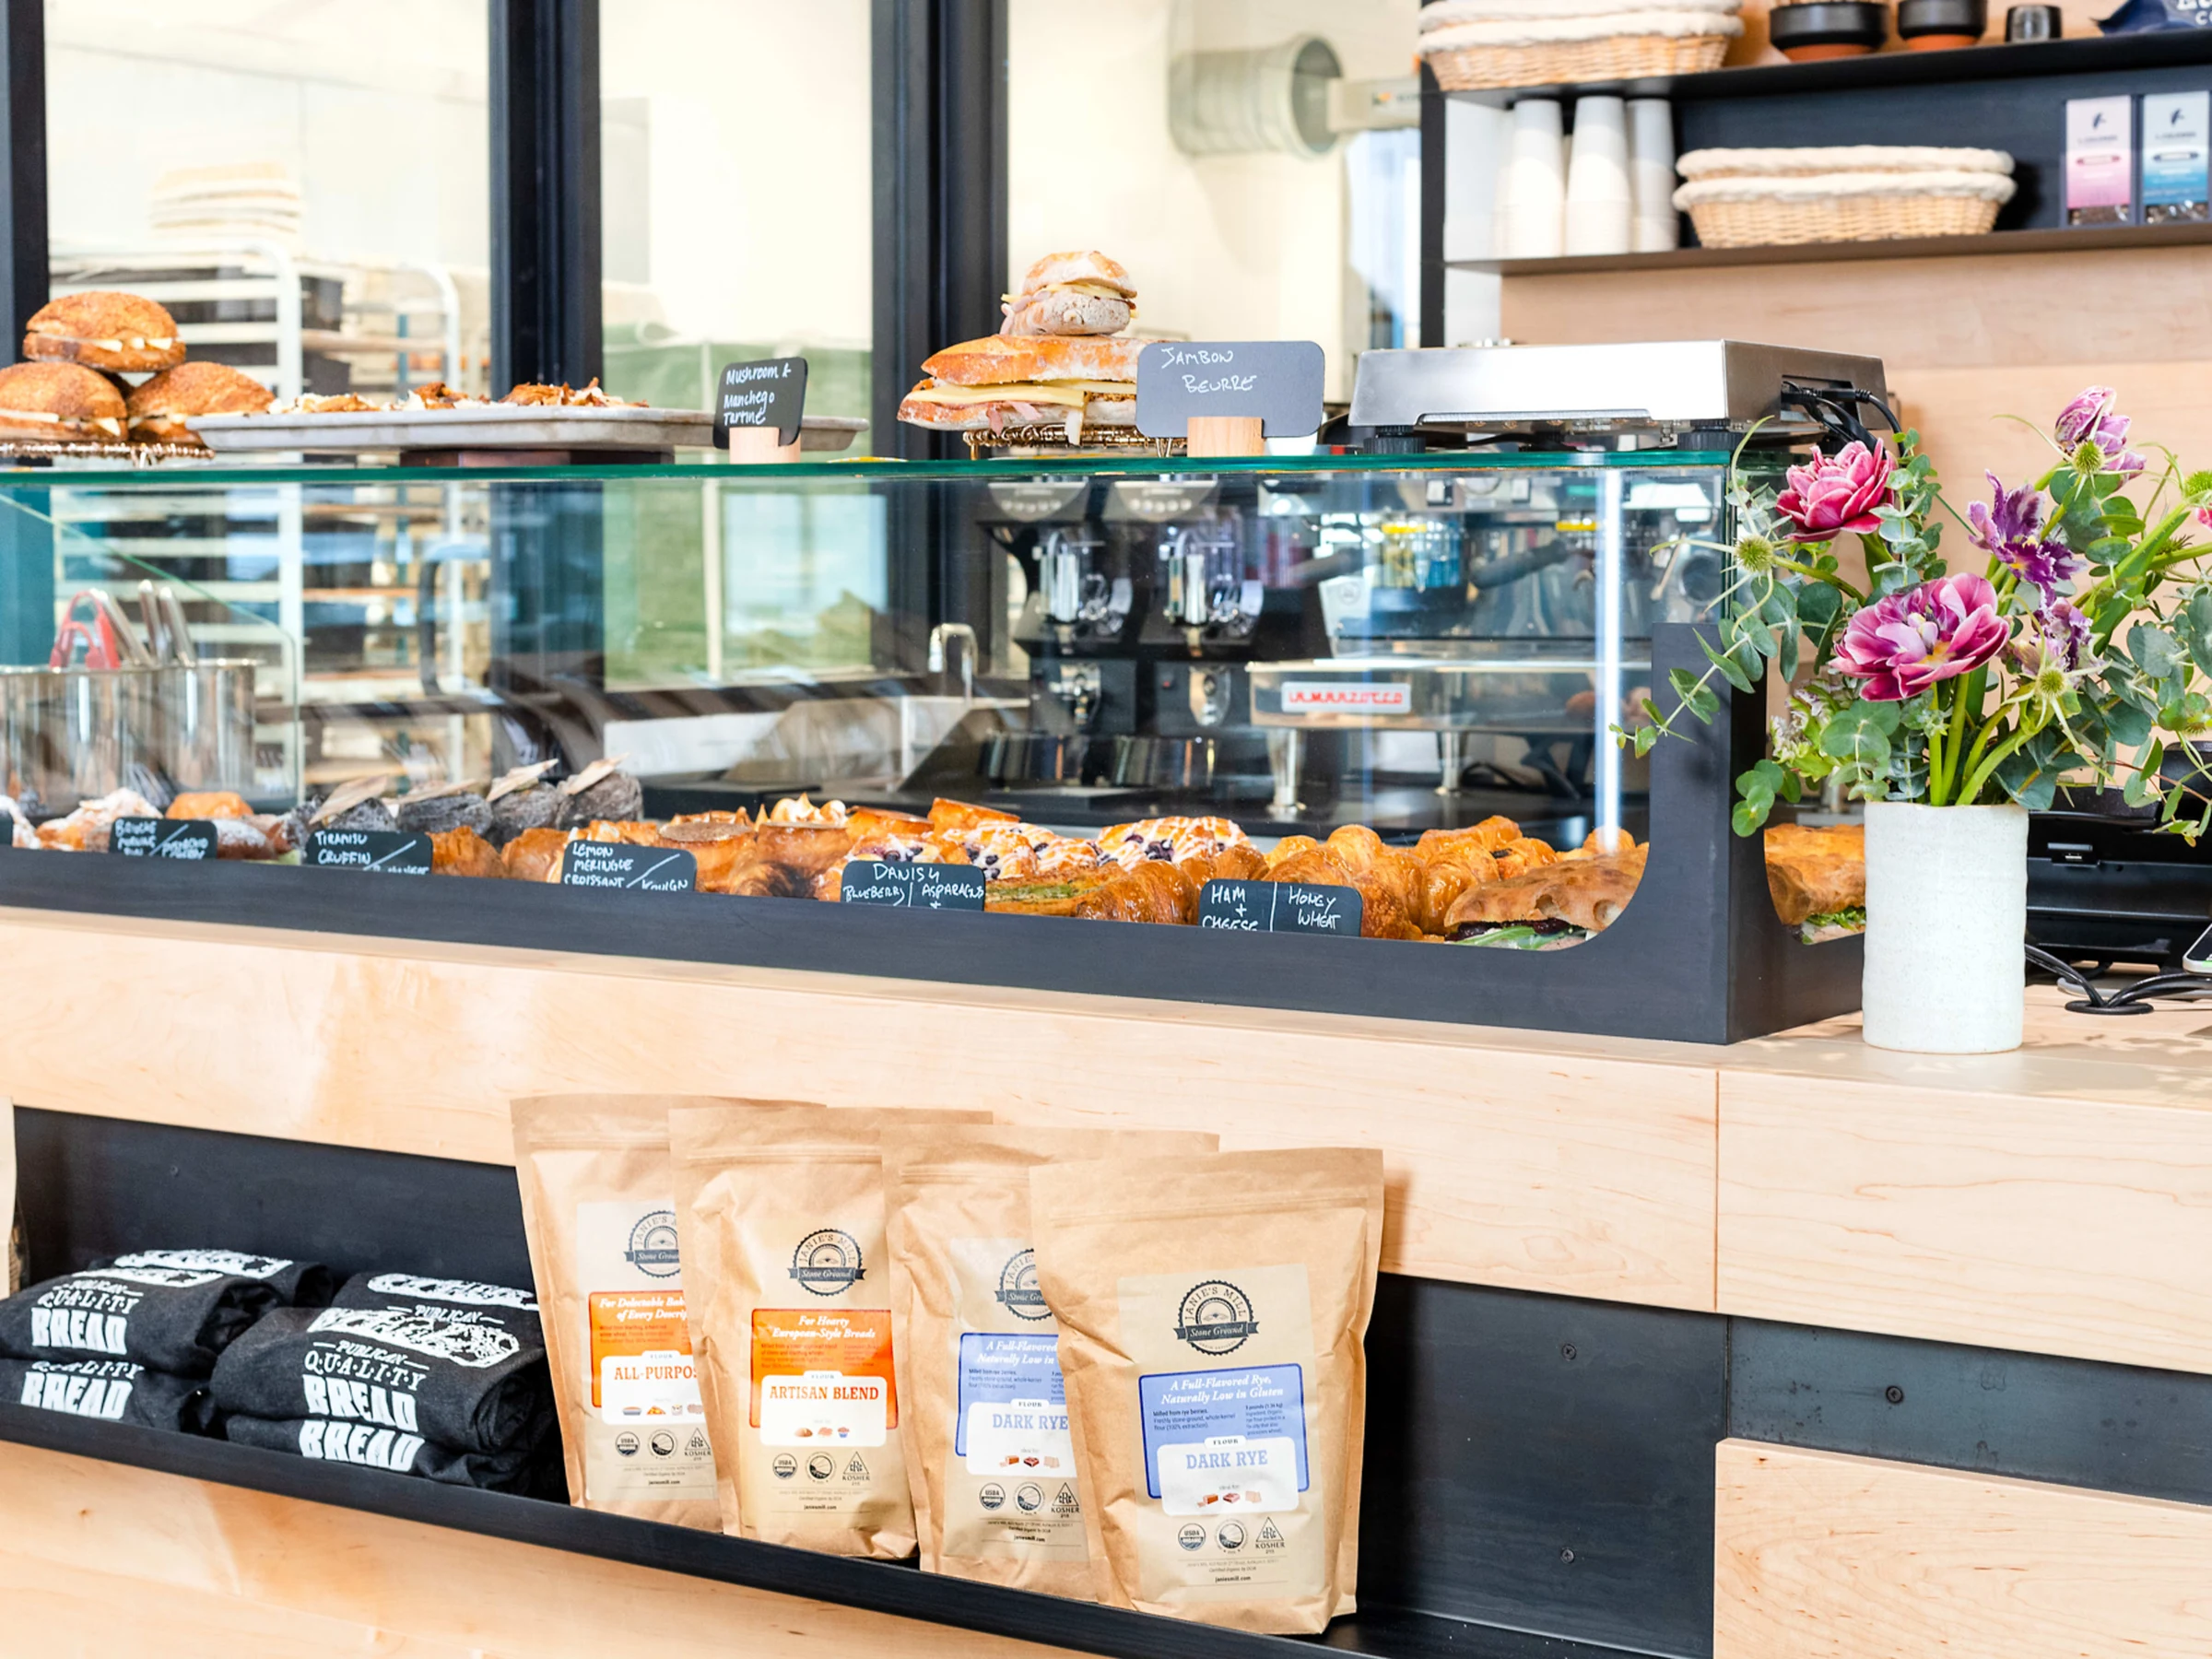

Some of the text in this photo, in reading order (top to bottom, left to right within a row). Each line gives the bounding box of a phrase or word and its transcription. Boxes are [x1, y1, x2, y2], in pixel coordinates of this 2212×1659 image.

[1161, 347, 1234, 369] JAMBON
[725, 366, 779, 385] Mushroom
[1182, 374, 1257, 394] BEURRE
[724, 390, 775, 414] Manchego
[314, 830, 368, 845] TIRAMISU
[317, 849, 371, 865] CRUFFIN
[571, 841, 614, 858] LEMON
[573, 858, 634, 873] MERINGUE
[873, 863, 940, 883] DANISH
[563, 874, 625, 888] CROISSANT
[842, 885, 905, 907] BLUEBERRY
[922, 882, 984, 900] ASPARAGUS
[1211, 884, 1246, 905] HAM
[1288, 885, 1336, 914] HONEY
[1202, 915, 1259, 931] CHEESE
[1298, 908, 1341, 930] WHEAT
[599, 1298, 616, 1308] For
[618, 1296, 664, 1307] Delectable
[1185, 1287, 1247, 1321] JANIE'S MILL
[415, 1304, 482, 1324] PUBLICAN
[616, 1310, 628, 1322] of
[628, 1310, 653, 1322] Every
[798, 1315, 850, 1328] For Hearty
[31, 1307, 127, 1355] BREAD
[772, 1327, 876, 1340] European-Style Breads
[1190, 1324, 1243, 1337] Stone Ground
[335, 1339, 407, 1365] PUBLICAN
[985, 1340, 1058, 1352] A Full-Flavored
[977, 1353, 1055, 1366] Naturally Low in
[1171, 1374, 1272, 1391] A Full-Flavored Rye,
[20, 1371, 134, 1420] BREAD
[770, 1385, 879, 1400] ARTISAN BLEND
[1160, 1387, 1284, 1405] Naturally Low in Gluten
[302, 1374, 418, 1432] BREAD
[992, 1413, 1068, 1430] DARK RYE
[299, 1419, 425, 1472] BREAD
[1185, 1450, 1268, 1469] DARK RYE
